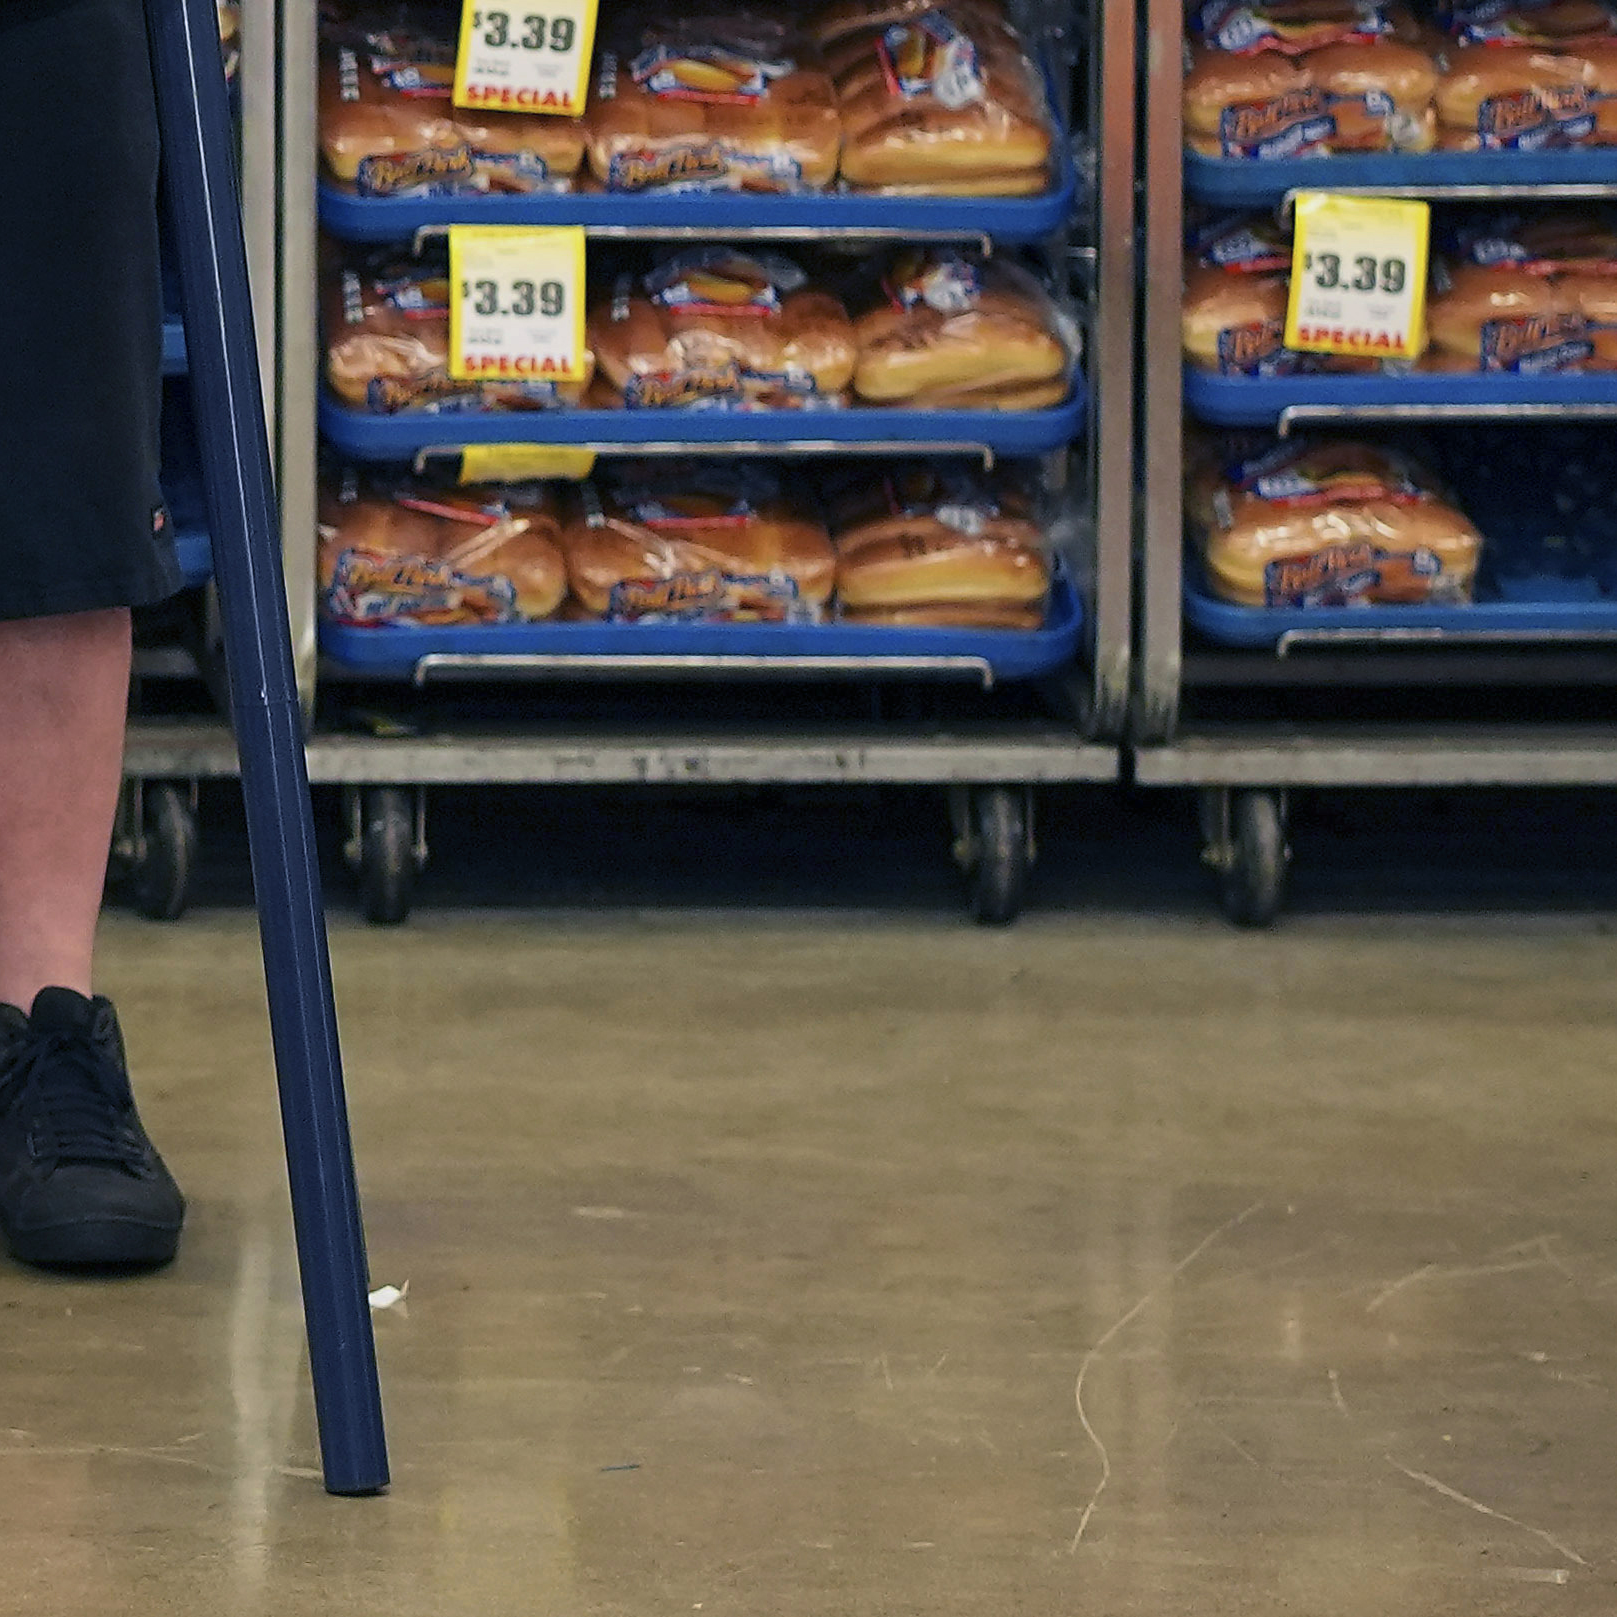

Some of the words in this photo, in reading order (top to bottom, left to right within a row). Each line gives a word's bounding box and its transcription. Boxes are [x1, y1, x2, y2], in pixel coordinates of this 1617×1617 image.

[473, 11, 576, 53] $3.39
[466, 83, 573, 111] SPECIAL
[1302, 253, 1408, 294] $3.39
[461, 280, 567, 317] $3.39
[1298, 325, 1409, 351] SPECIAL
[465, 354, 573, 376] SPECIAL
